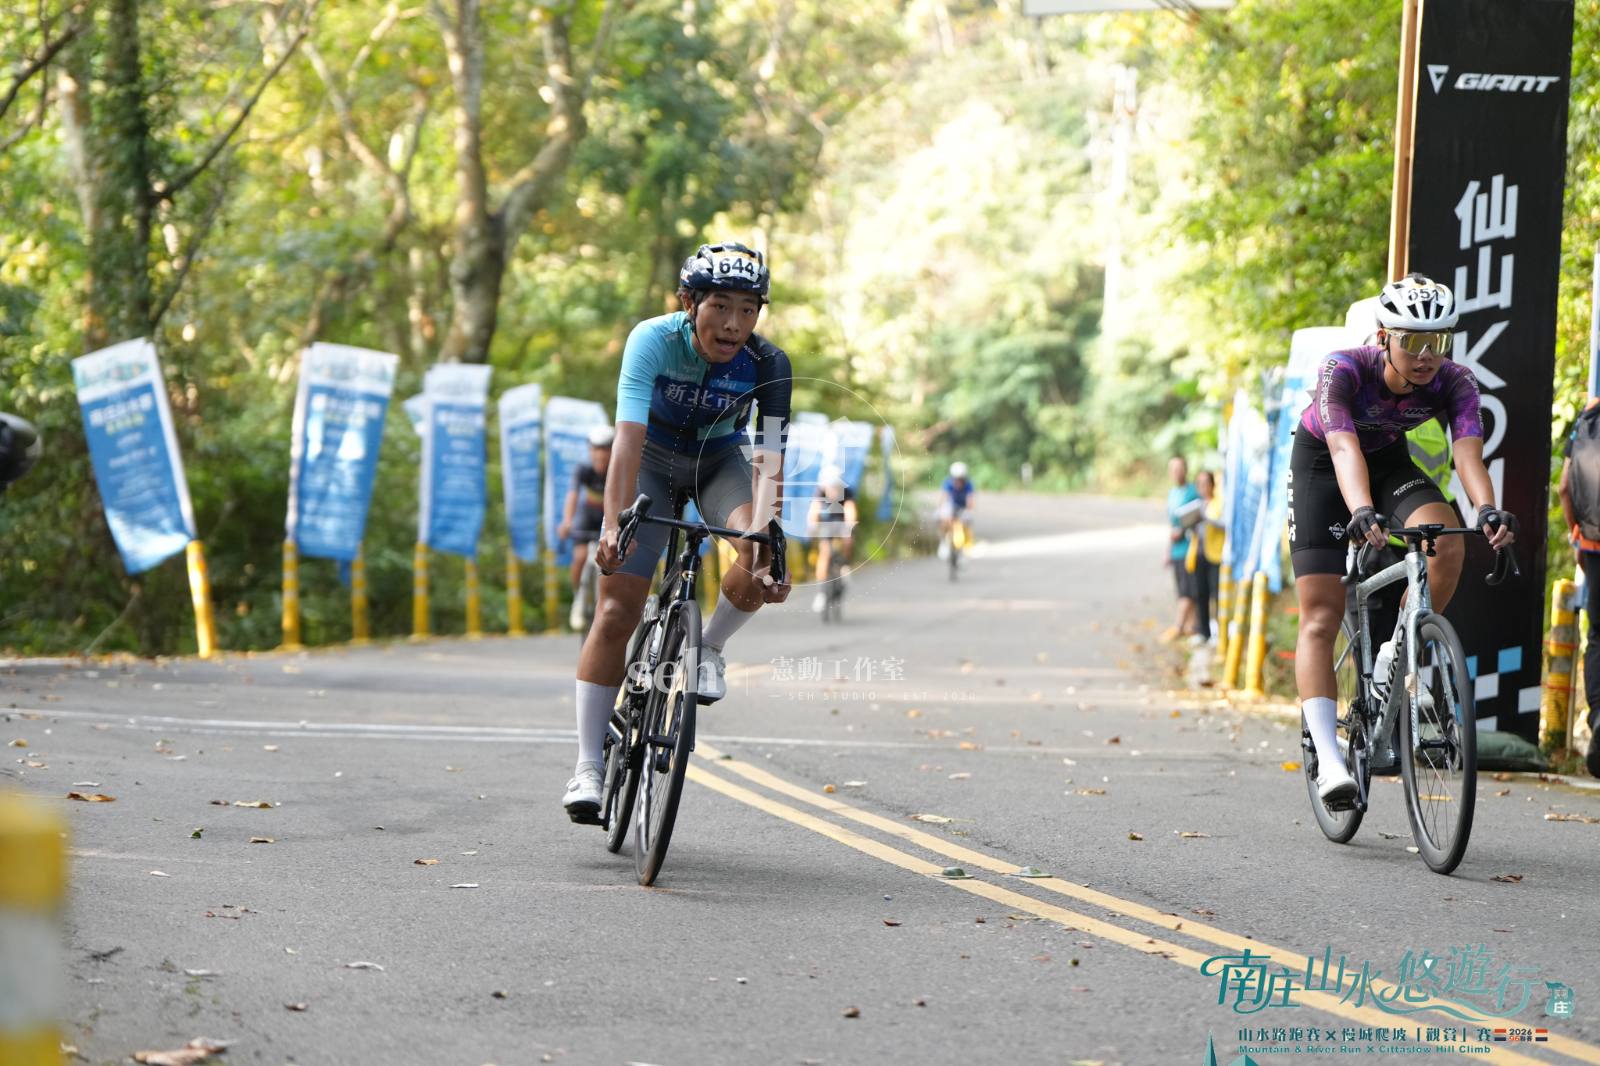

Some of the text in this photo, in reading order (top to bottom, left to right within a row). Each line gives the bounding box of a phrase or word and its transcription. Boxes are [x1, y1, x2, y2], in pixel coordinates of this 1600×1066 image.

[1454, 72, 1560, 93] GIANT
[719, 257, 755, 277] 644
[1408, 288, 1439, 302] 651
[664, 382, 738, 409] 新北市
